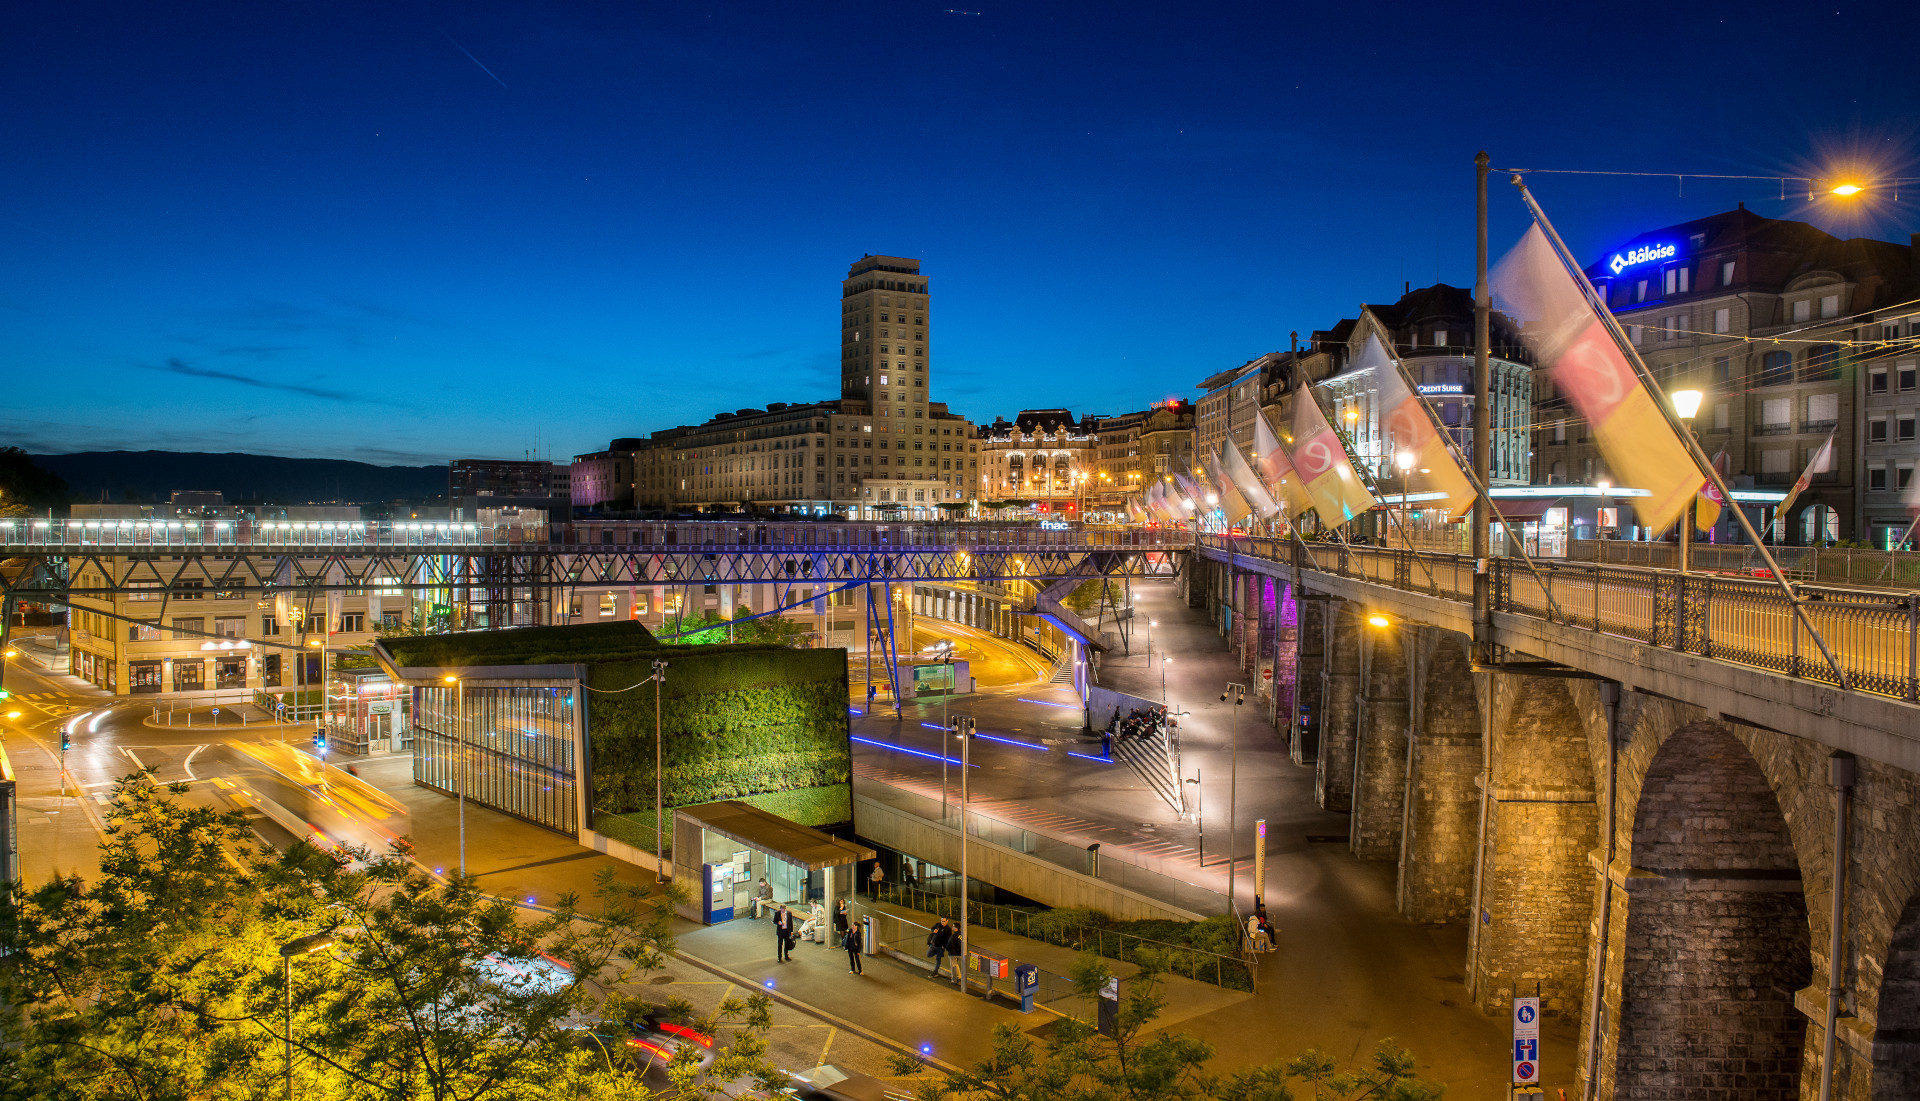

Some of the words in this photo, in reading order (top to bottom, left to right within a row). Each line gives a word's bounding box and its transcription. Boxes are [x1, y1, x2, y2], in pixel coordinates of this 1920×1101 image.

[1628, 243, 1675, 265] Bâloise
[1441, 384, 1463, 393] SUISSE
[1041, 520, 1068, 530] fnac
